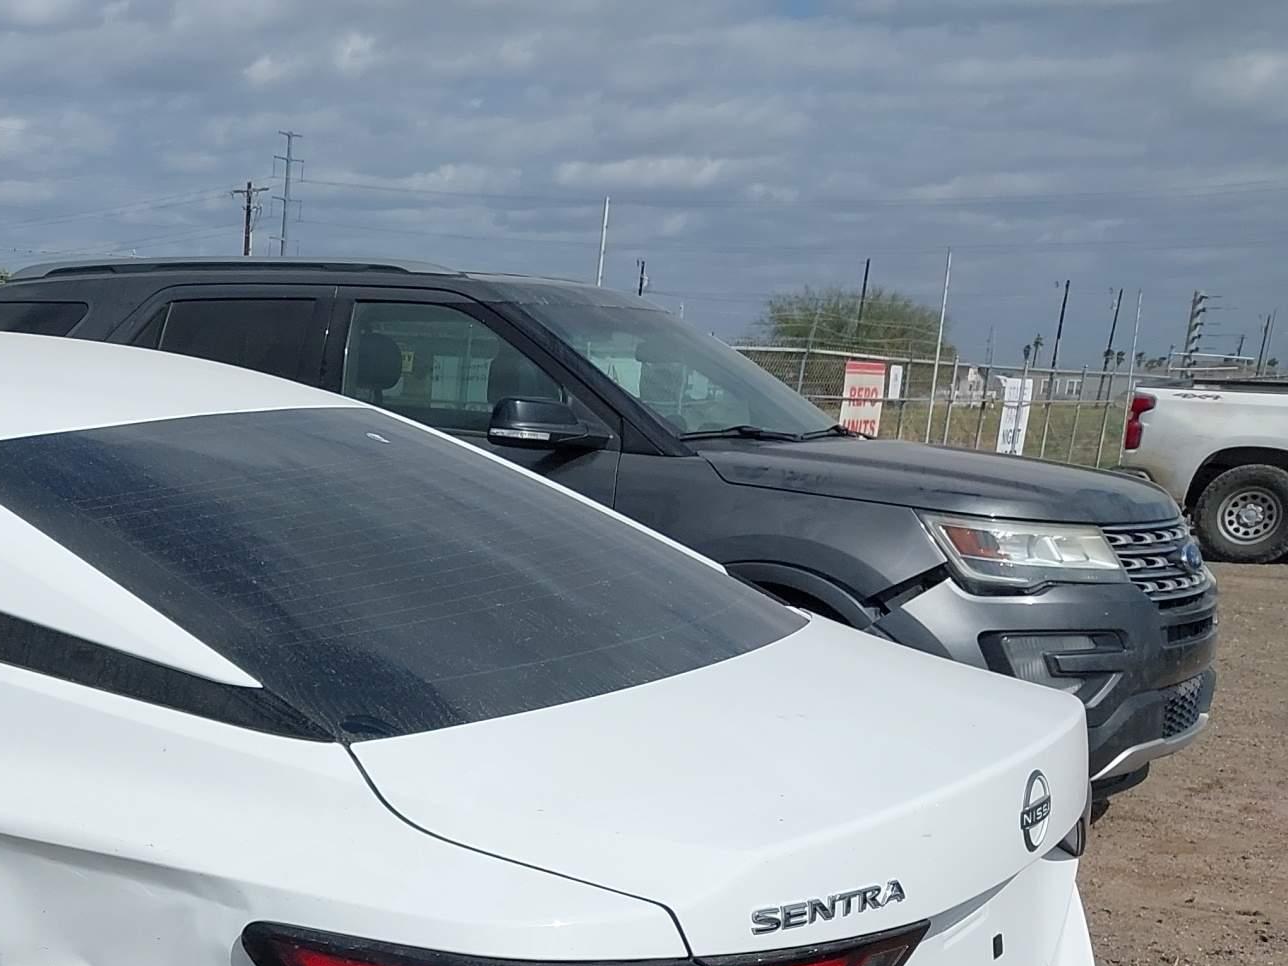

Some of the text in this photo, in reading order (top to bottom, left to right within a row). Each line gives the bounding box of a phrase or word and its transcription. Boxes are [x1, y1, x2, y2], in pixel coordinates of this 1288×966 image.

[848, 386, 879, 407] REPO
[1022, 802, 1050, 827] NISS
[751, 879, 906, 936] SENTRA
